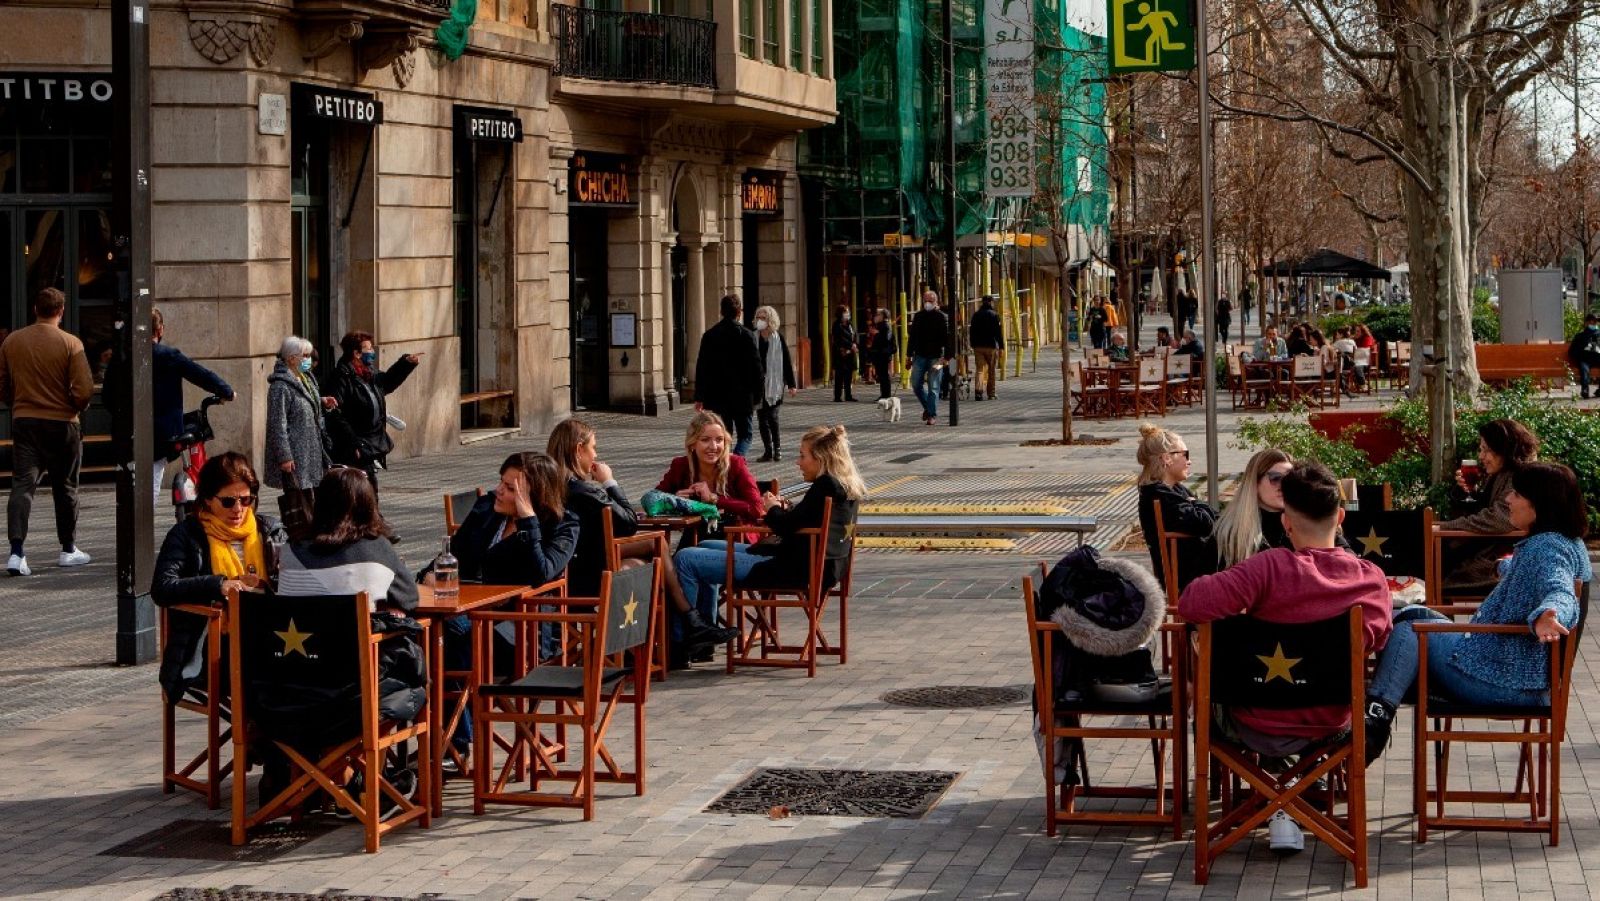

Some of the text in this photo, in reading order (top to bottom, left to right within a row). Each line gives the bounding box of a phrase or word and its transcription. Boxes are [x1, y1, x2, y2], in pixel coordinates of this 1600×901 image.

[314, 94, 375, 121] PETITBO
[471, 118, 515, 139] PETITBO
[990, 117, 1028, 139] 934
[990, 142, 1029, 163] 508
[990, 166, 1030, 187] 933
